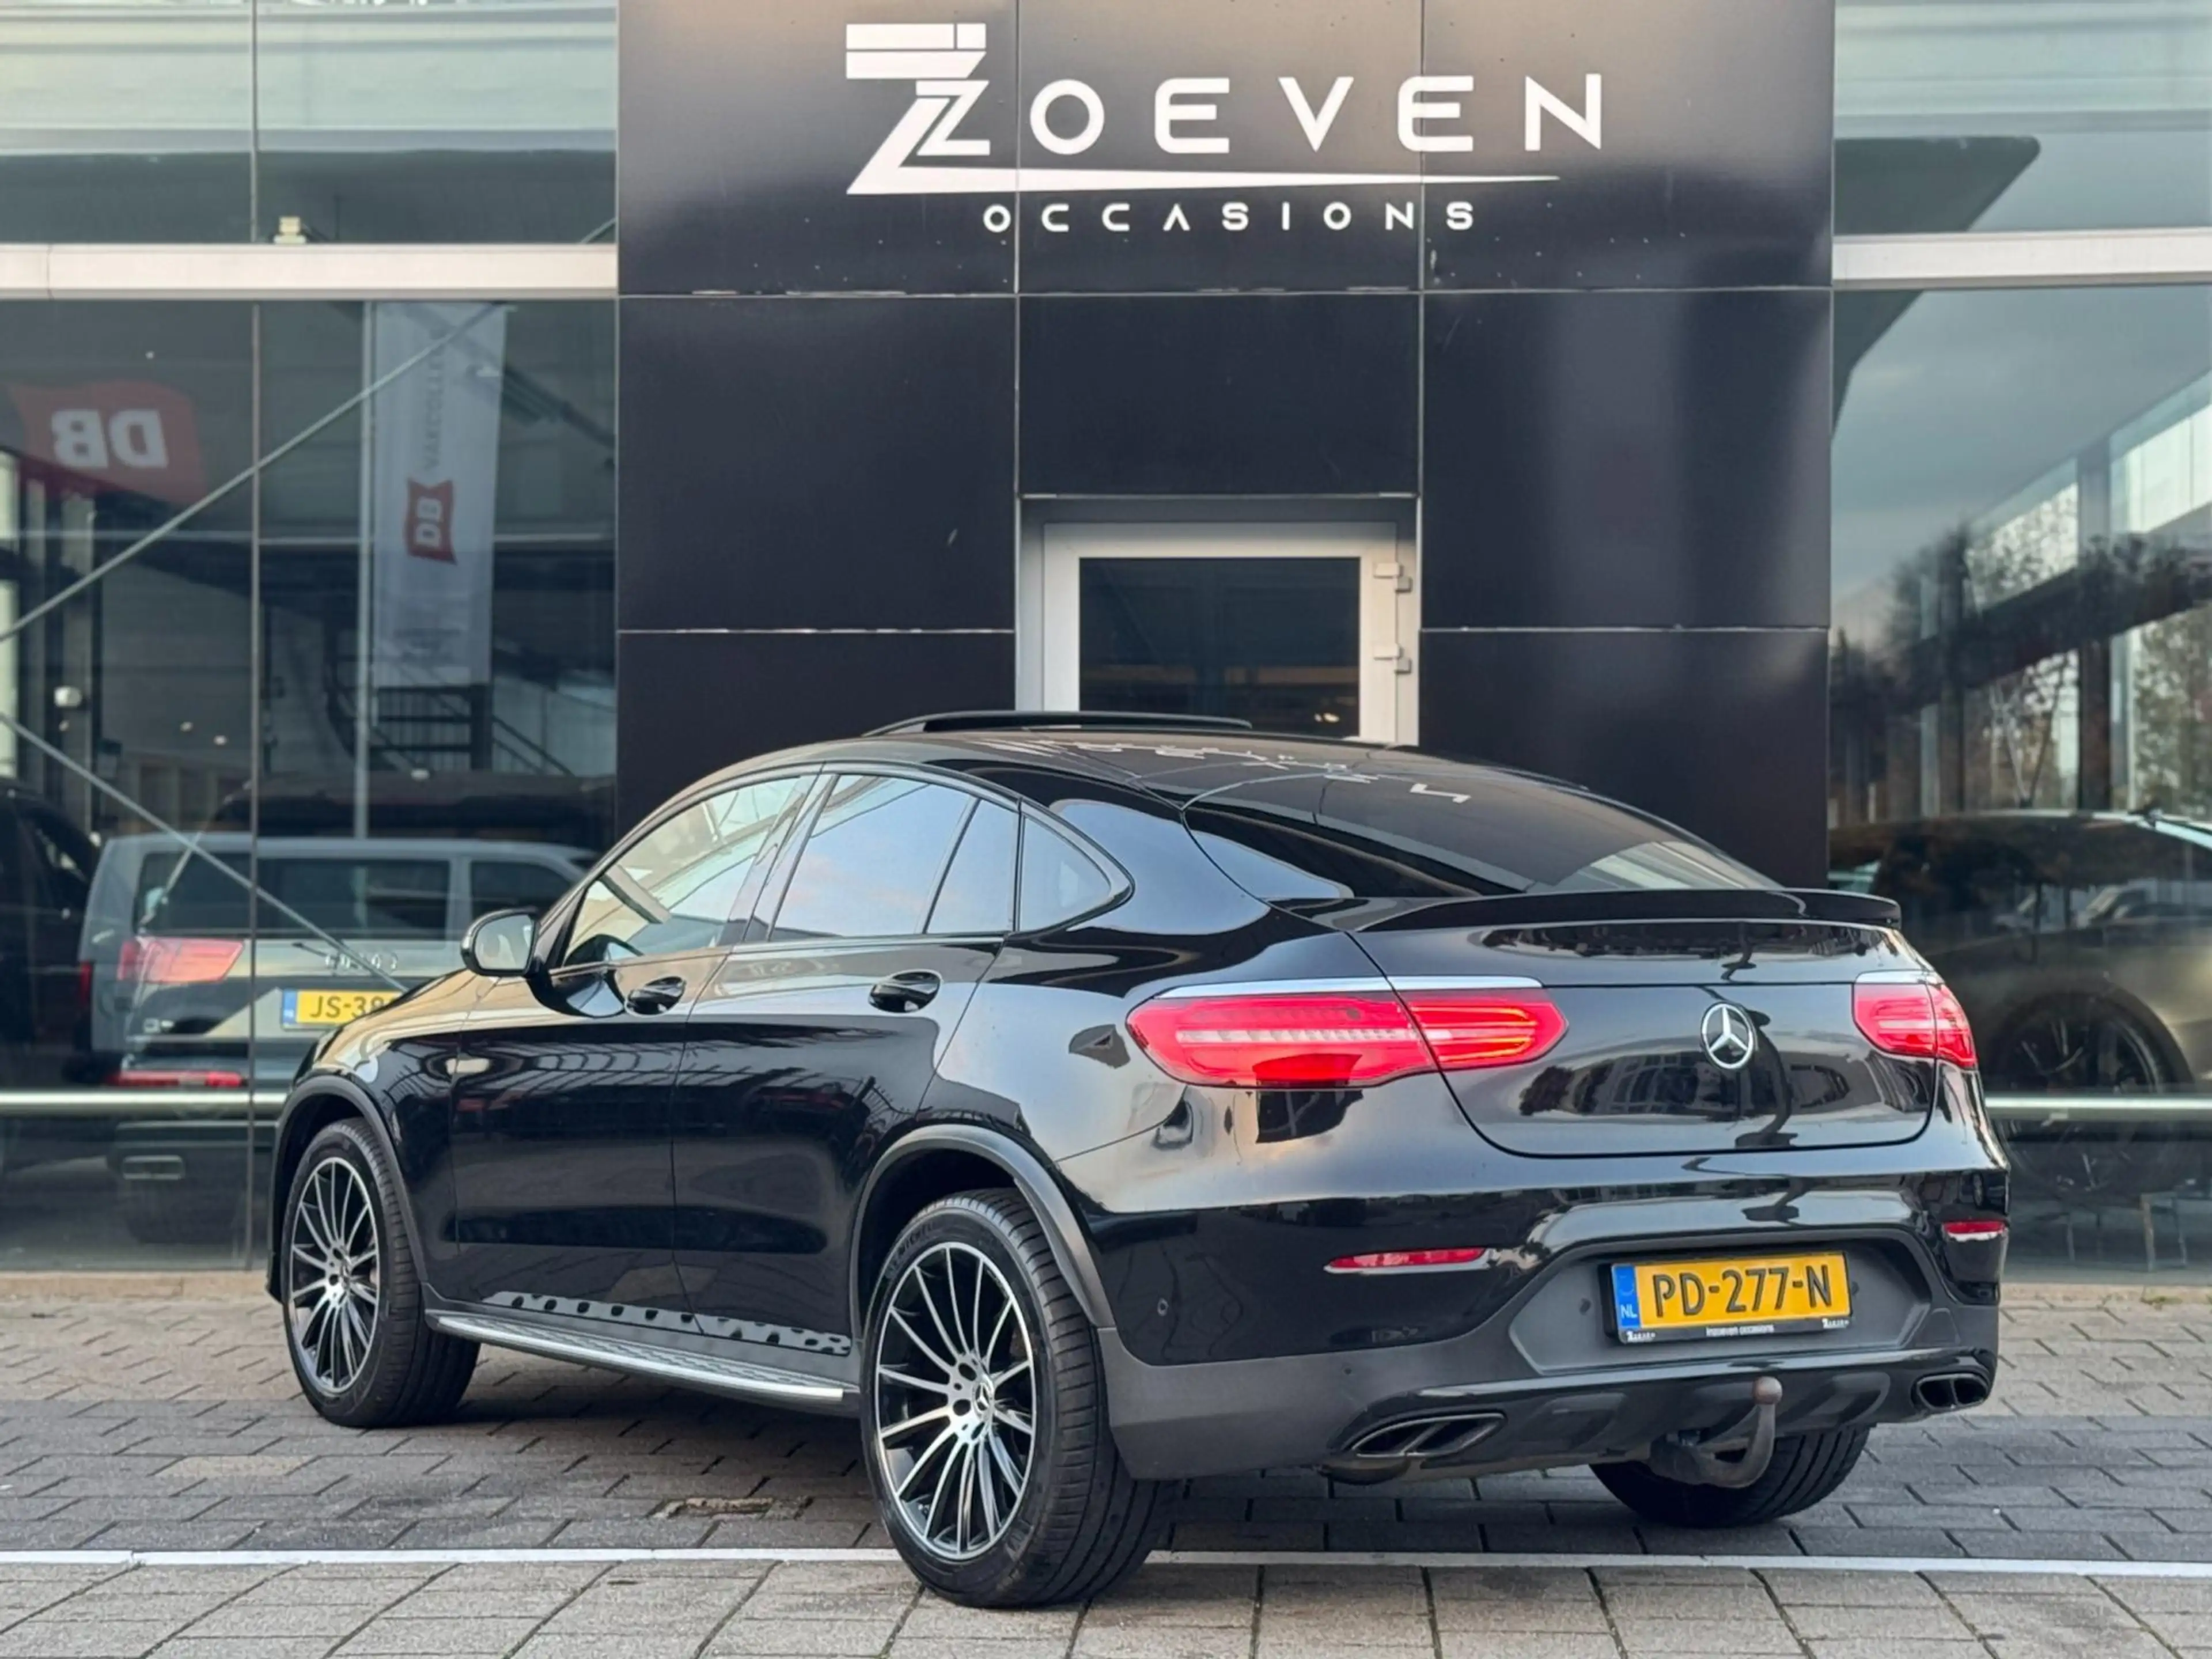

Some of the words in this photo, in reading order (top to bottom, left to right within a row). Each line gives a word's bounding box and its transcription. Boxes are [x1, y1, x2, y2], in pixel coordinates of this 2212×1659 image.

[983, 201, 1474, 232] OCCASIONS
[414, 496, 444, 548] DB
[309, 995, 397, 1019] JS-38
[1652, 1264, 1832, 1319] PD-277-N
[1620, 1304, 1637, 1319] NL
